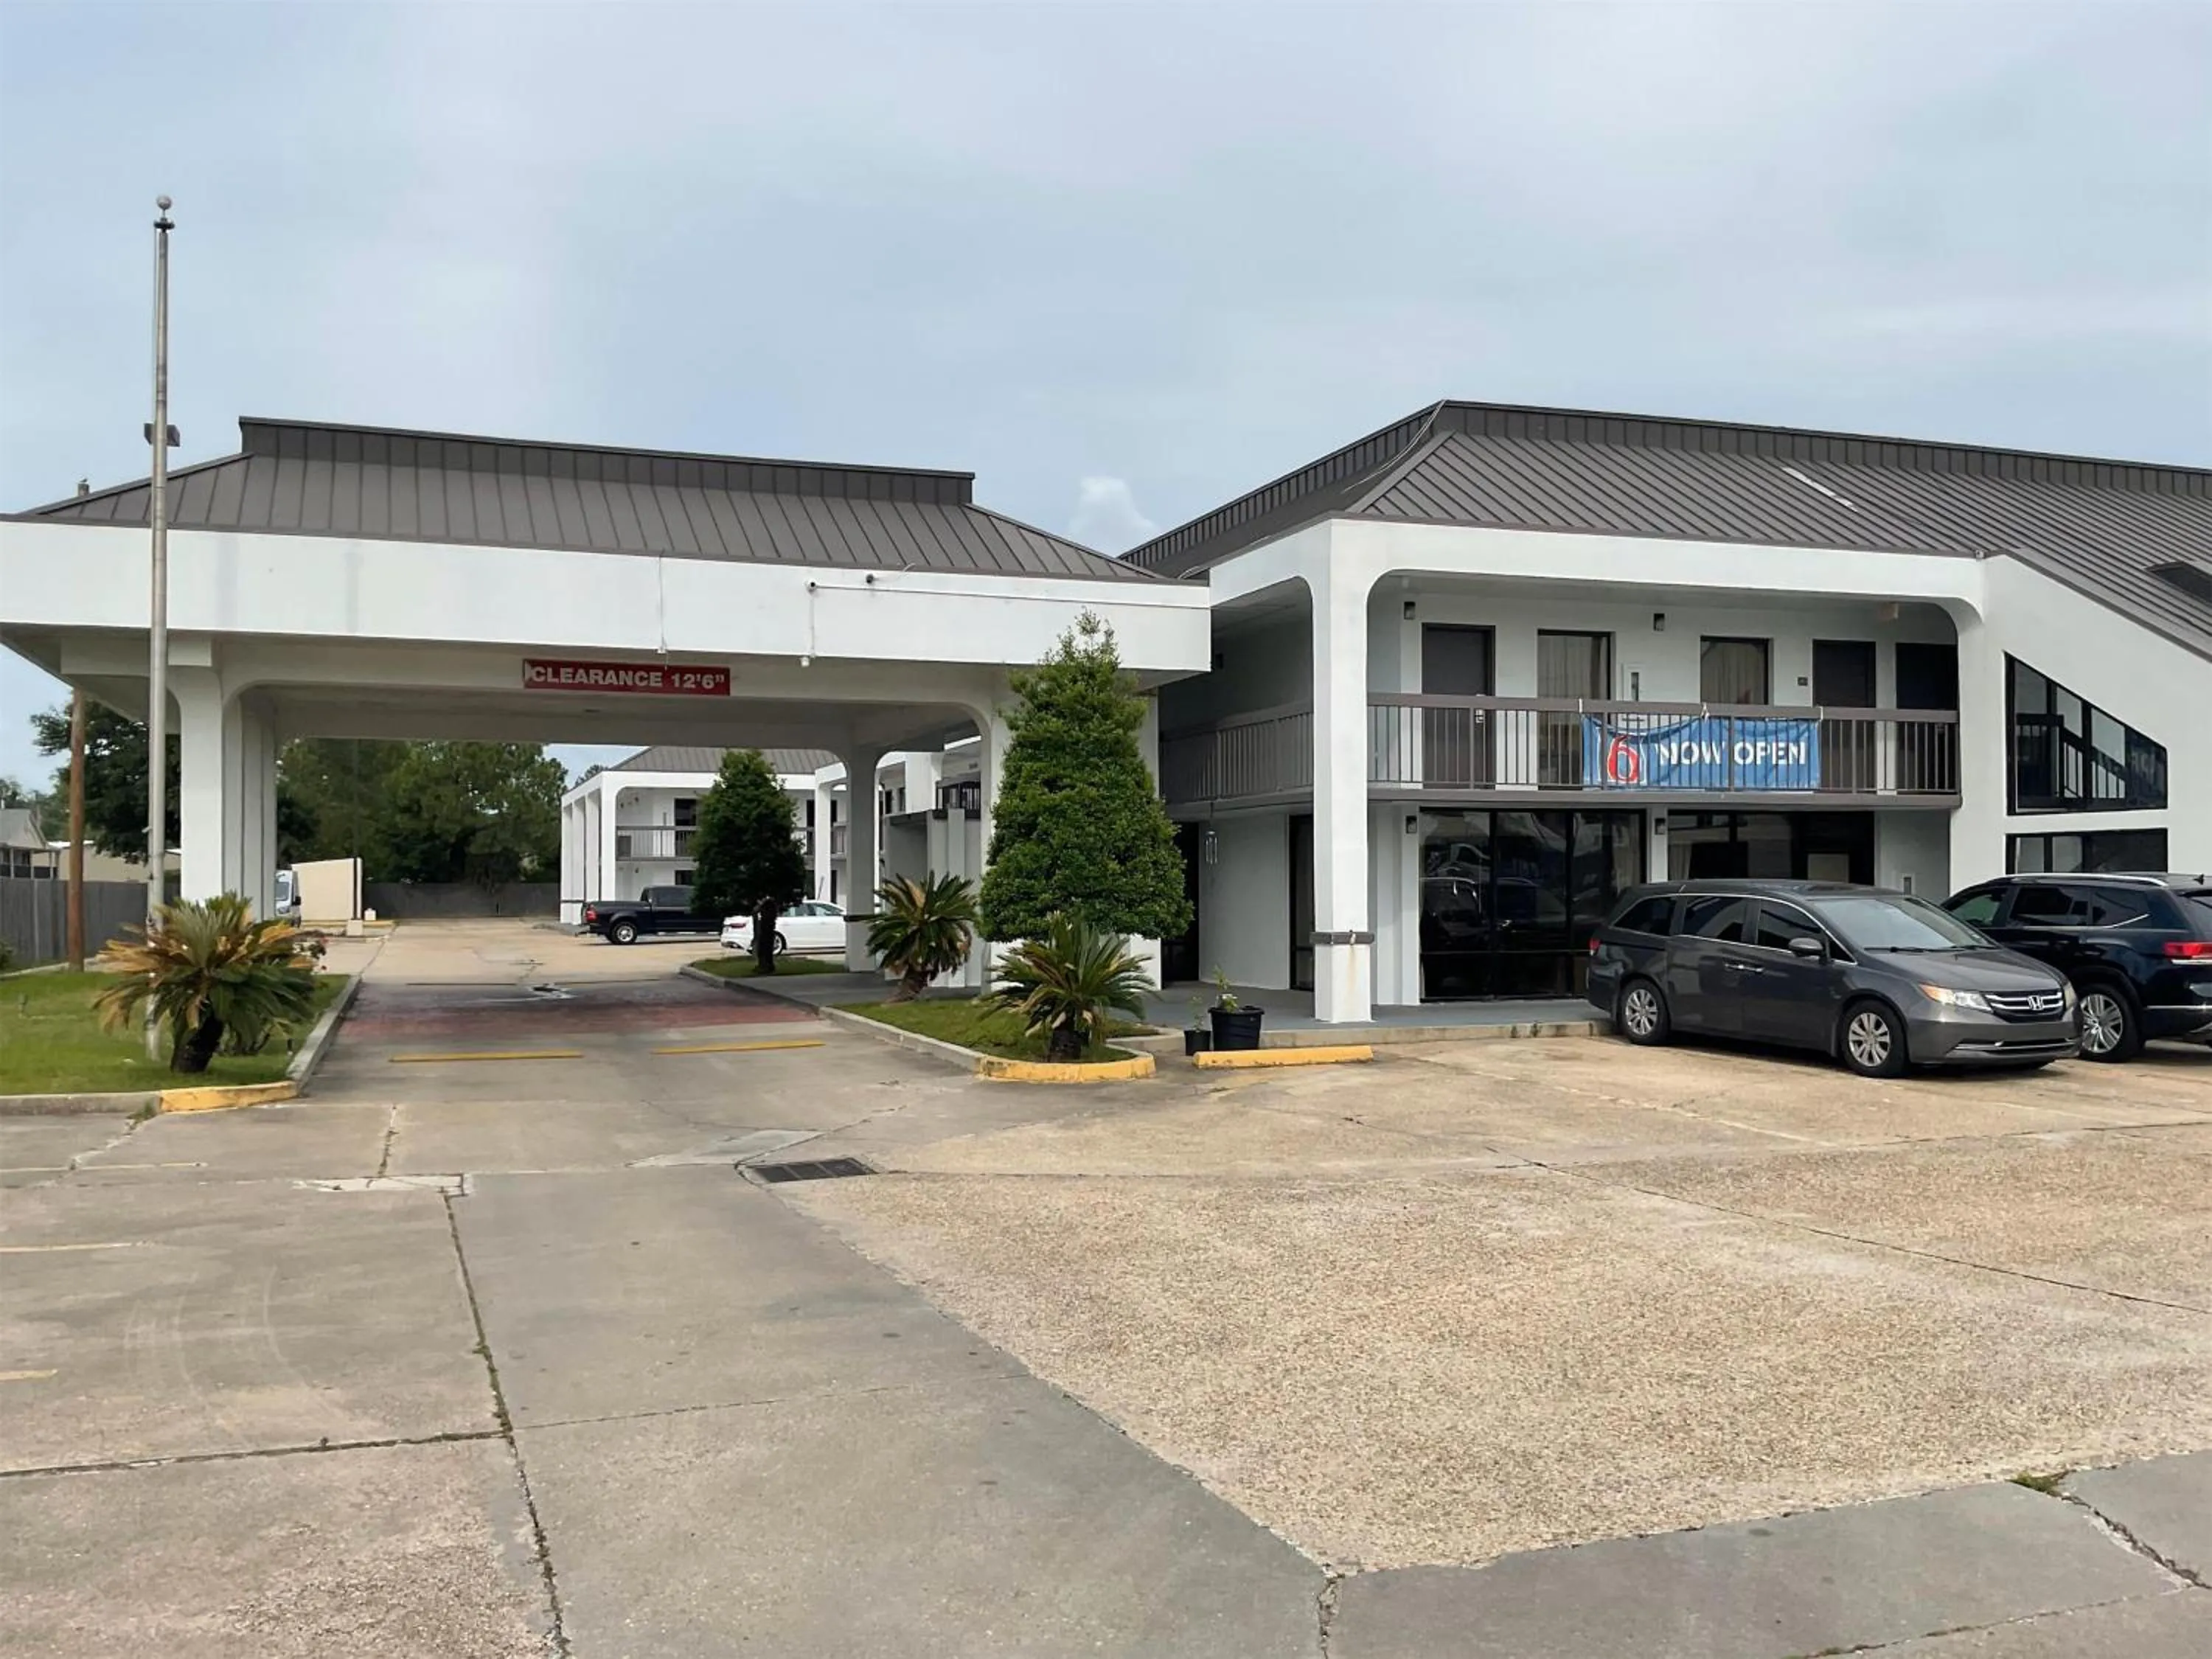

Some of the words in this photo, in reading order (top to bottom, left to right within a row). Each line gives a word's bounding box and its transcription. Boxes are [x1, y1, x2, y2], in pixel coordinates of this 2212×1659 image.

[531, 666, 662, 686] CLEARANCE
[1607, 736, 1638, 784] 6
[1655, 741, 1725, 765] NOW
[1733, 742, 1806, 765] OPEN
